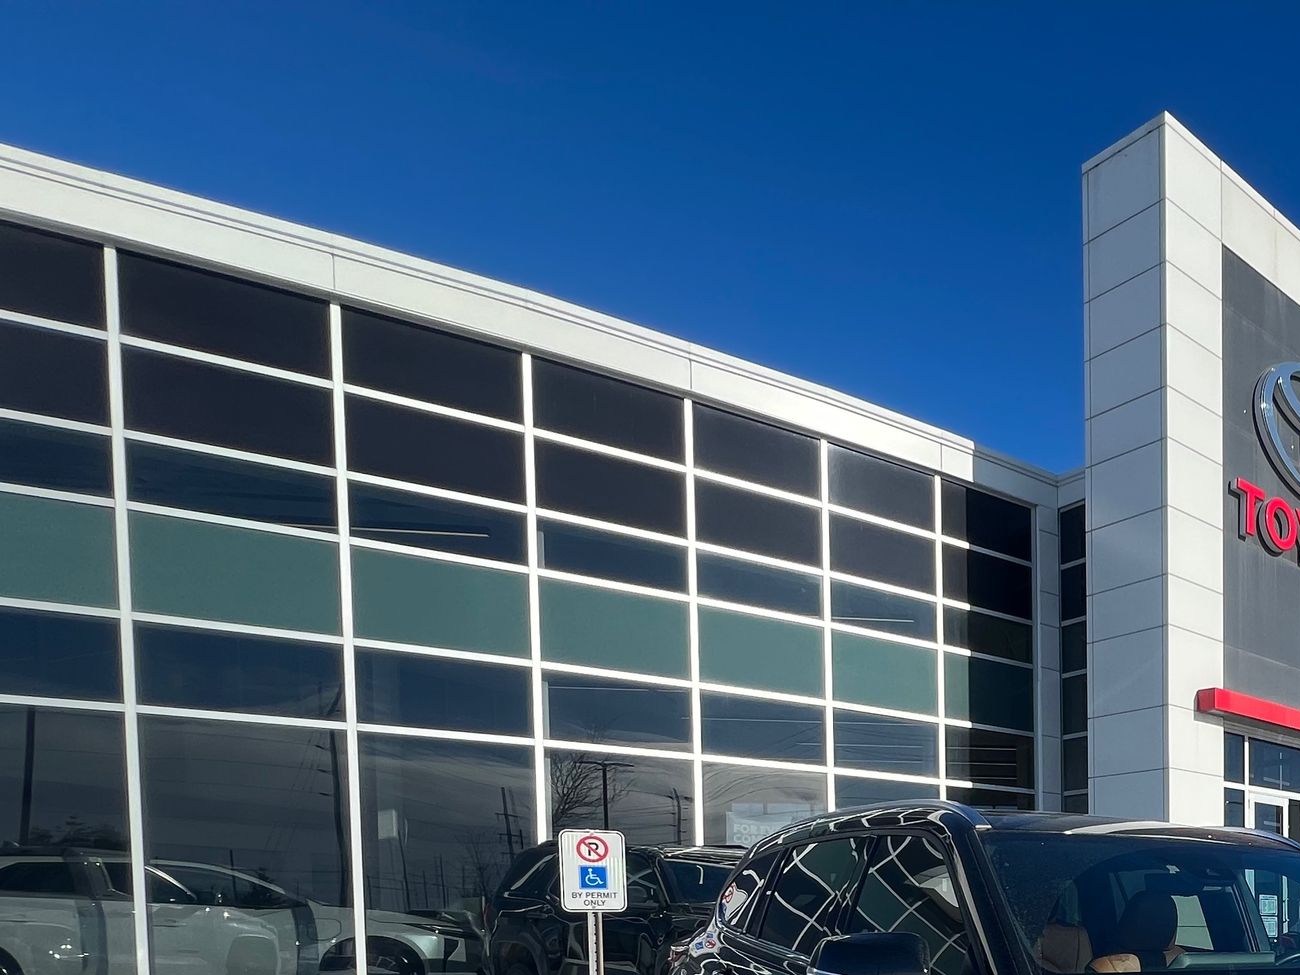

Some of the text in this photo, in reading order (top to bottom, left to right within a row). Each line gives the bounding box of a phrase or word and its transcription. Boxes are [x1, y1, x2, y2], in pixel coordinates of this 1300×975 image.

[571, 891, 618, 899] BY PERMIT
[583, 899, 606, 907] ONLY
